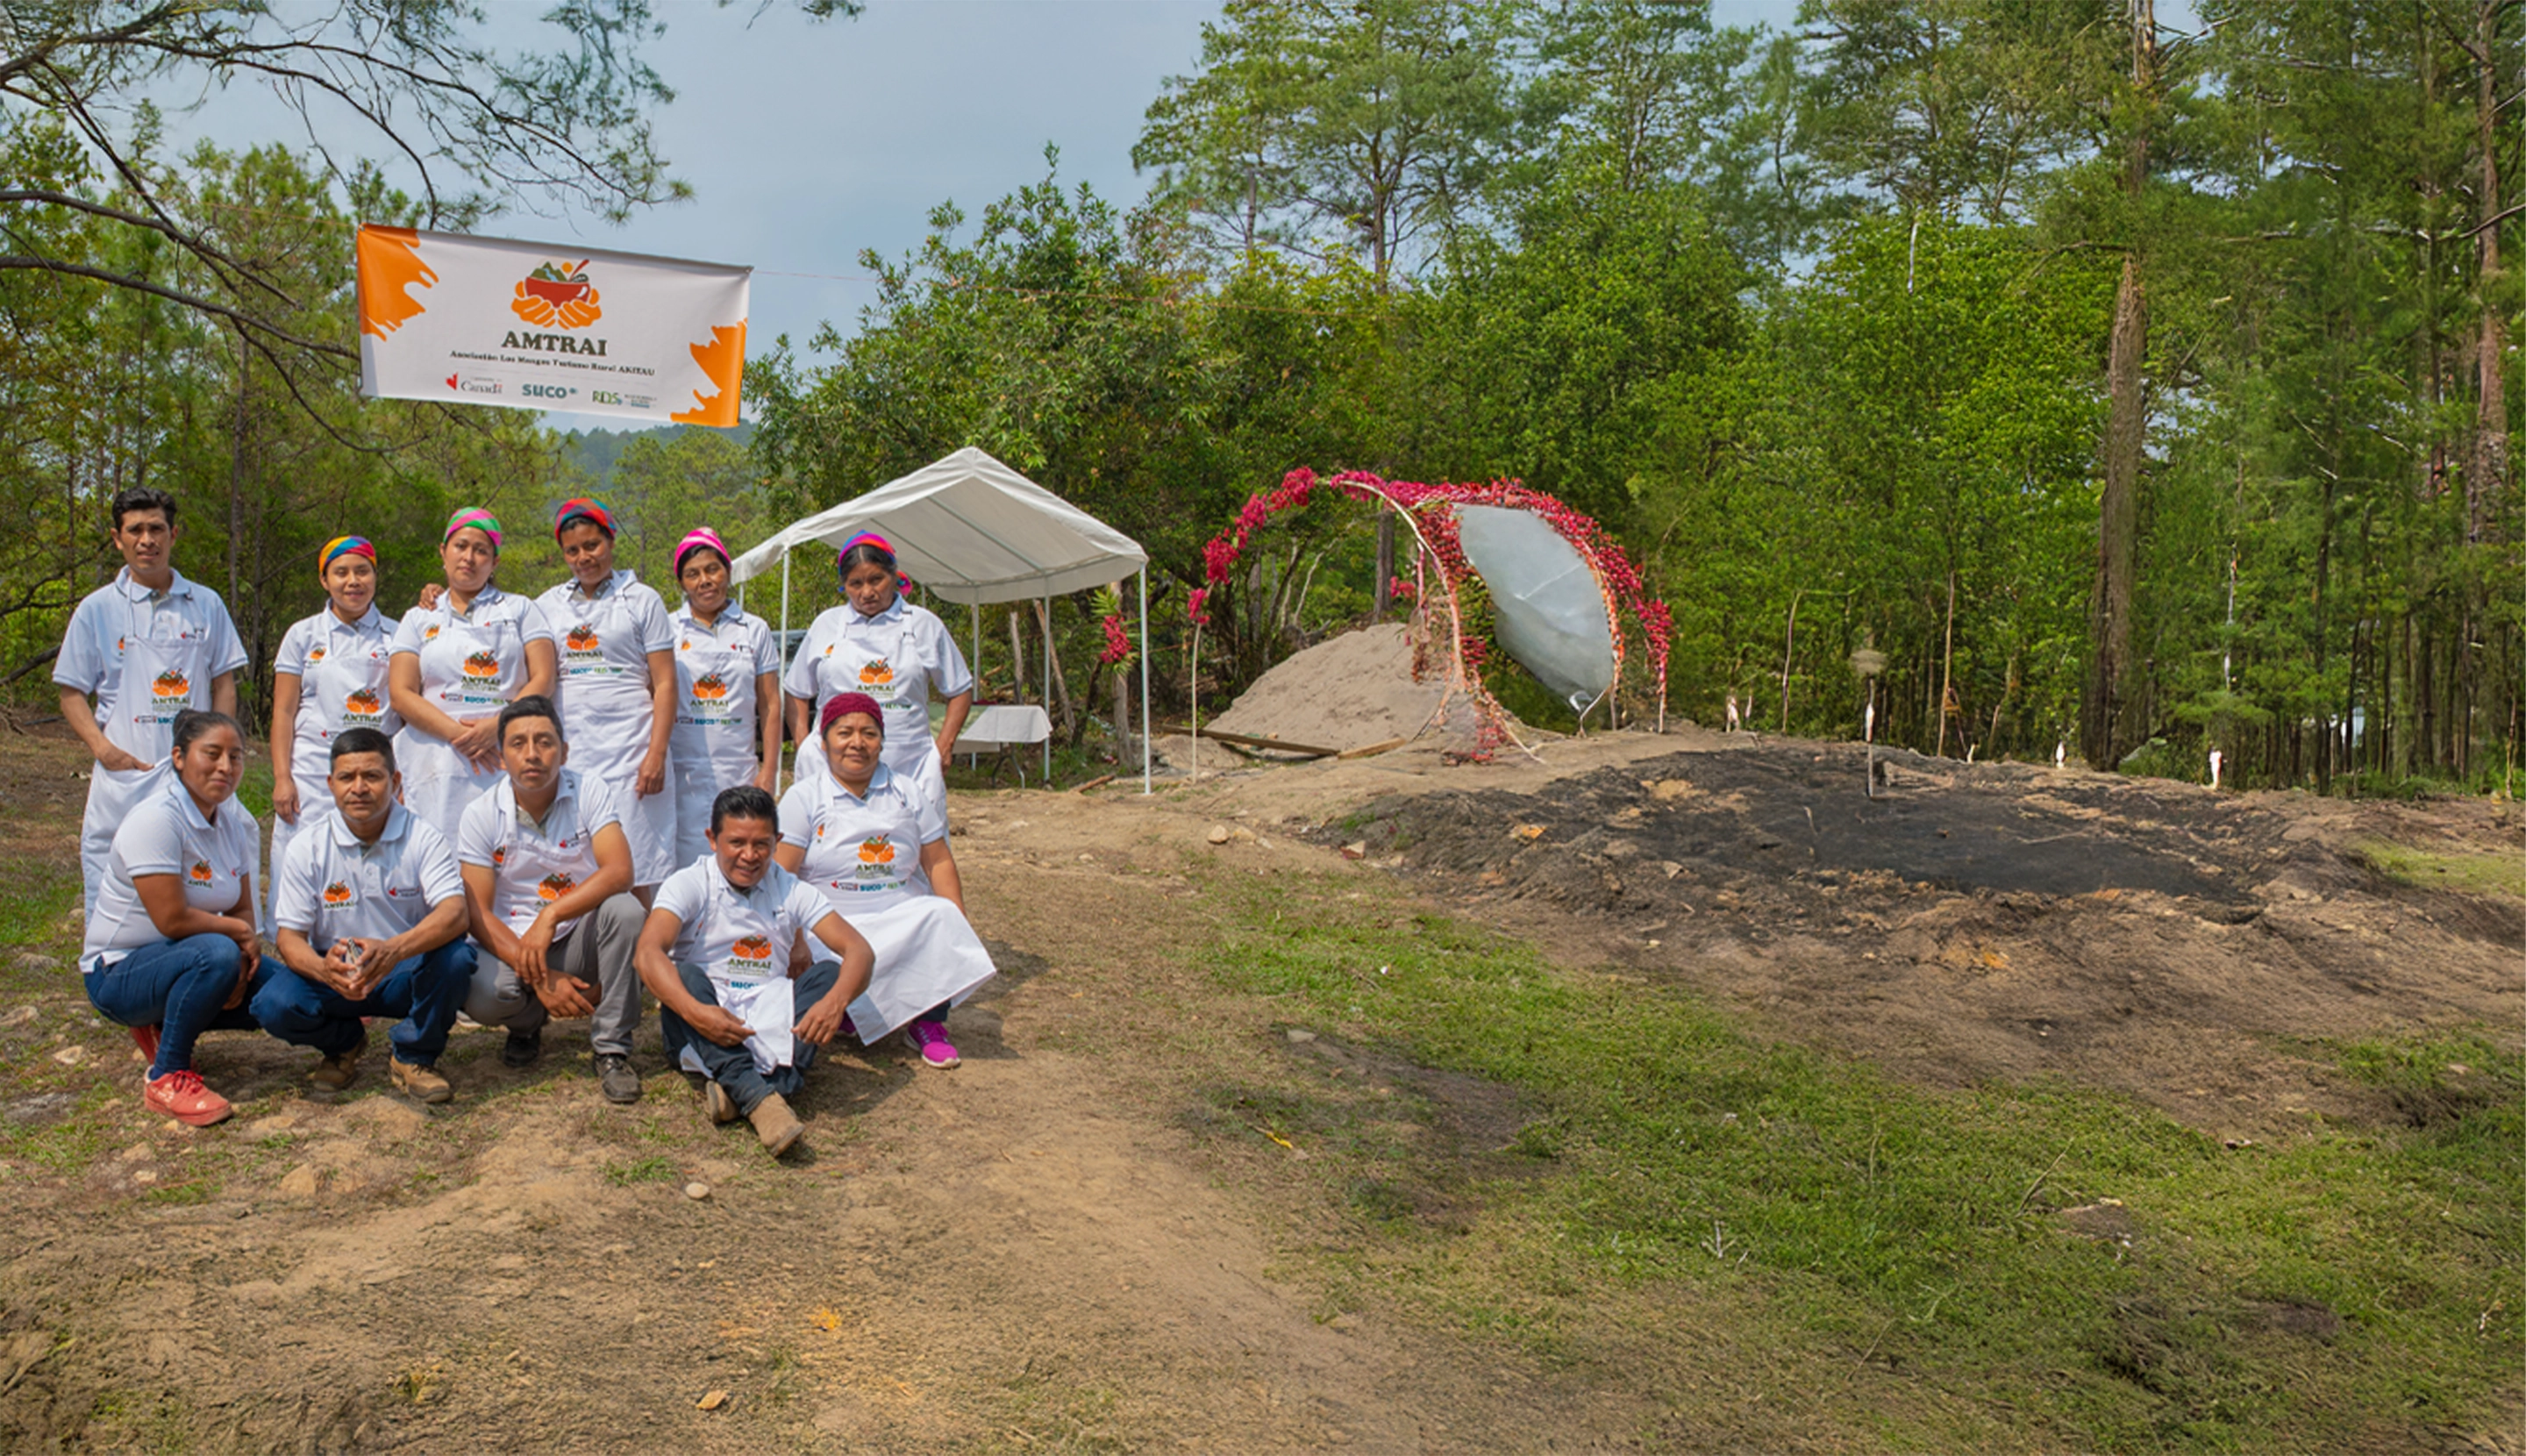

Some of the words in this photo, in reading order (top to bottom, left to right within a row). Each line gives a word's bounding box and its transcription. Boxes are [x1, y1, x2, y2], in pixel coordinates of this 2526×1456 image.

[501, 331, 608, 356] AMTRAI
[553, 359, 589, 368] Turismo
[591, 362, 617, 372] Rural
[461, 675, 501, 687] AMTRAI
[343, 713, 382, 724] AMTRAI
[727, 958, 772, 969] AMTRAI
